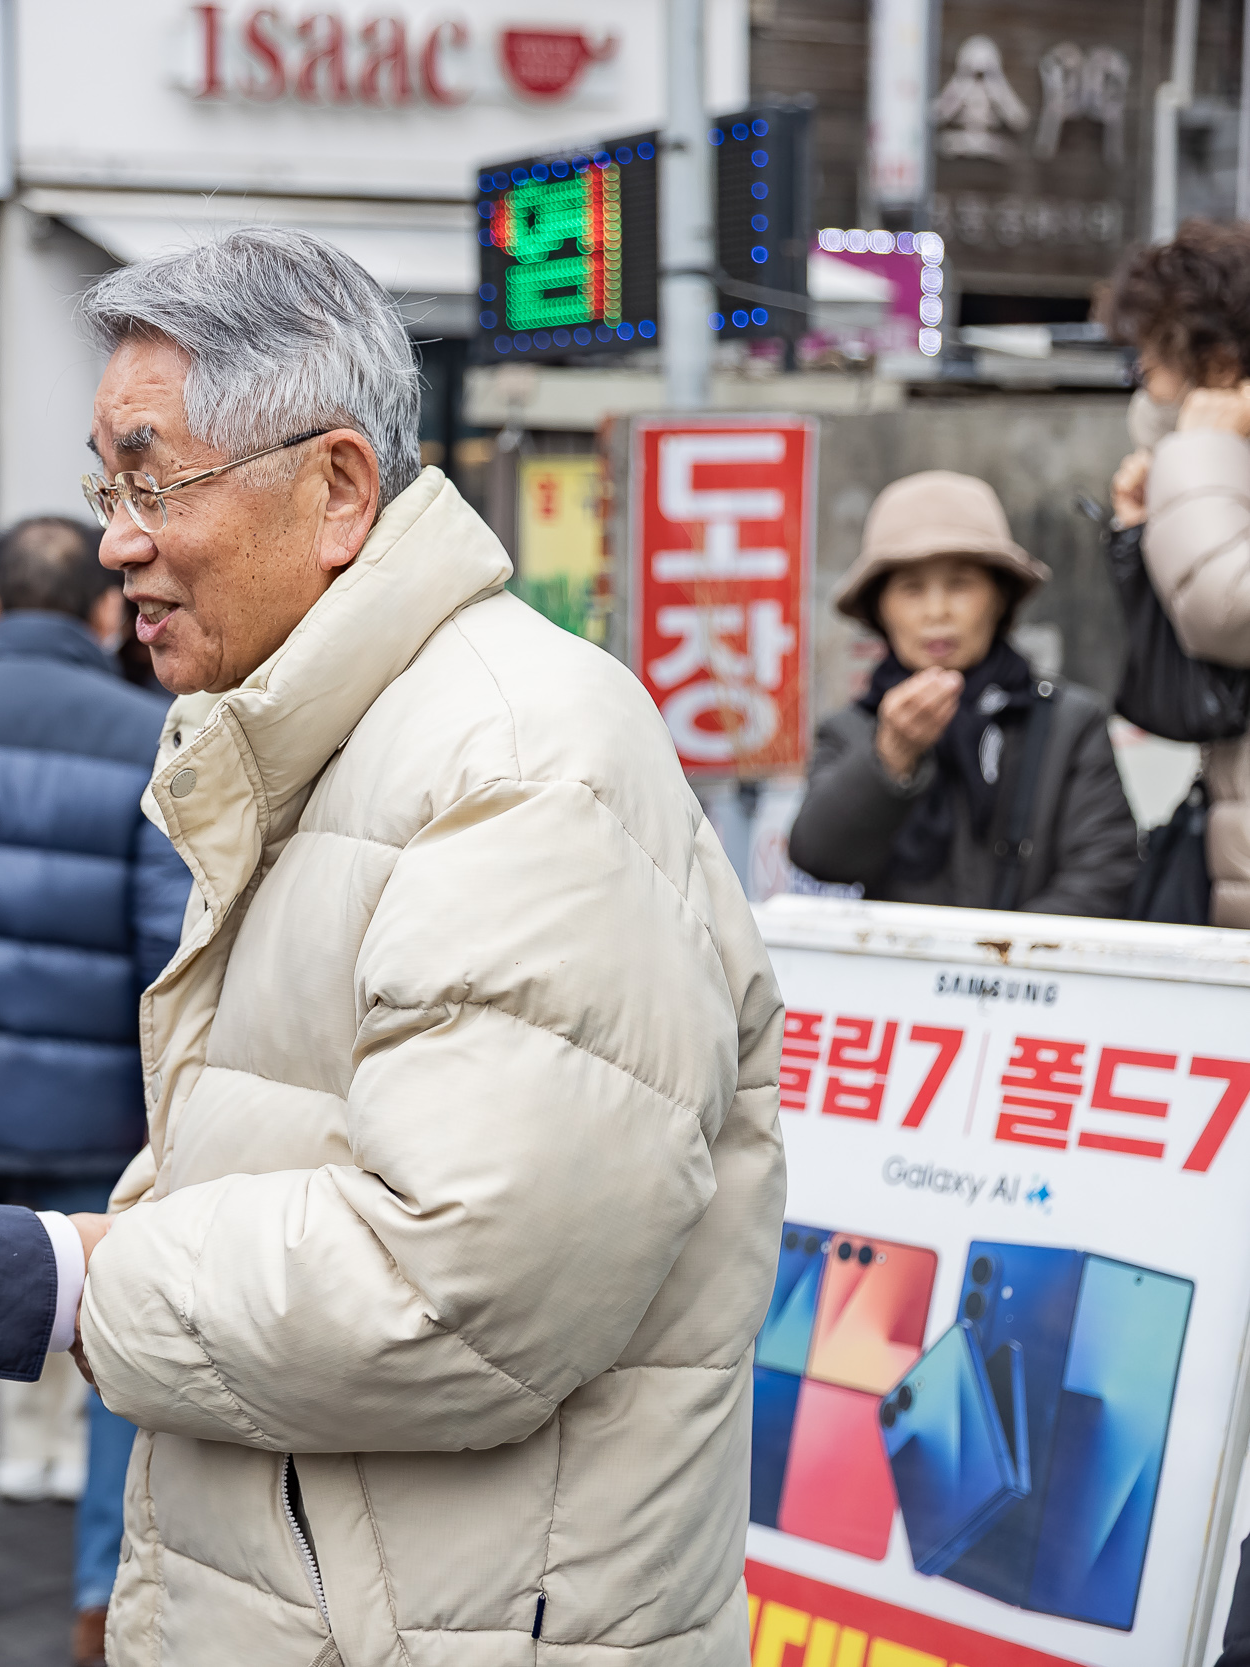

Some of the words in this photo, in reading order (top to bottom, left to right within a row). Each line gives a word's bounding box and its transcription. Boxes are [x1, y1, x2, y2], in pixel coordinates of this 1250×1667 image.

[188, 6, 472, 107] Isaac
[650, 432, 797, 765] 도장
[934, 971, 1059, 1005] SAMSUNG
[995, 1036, 1250, 1174] 폴드7
[882, 1154, 987, 1205] Galaxy
[989, 1175, 1020, 1207] AI
